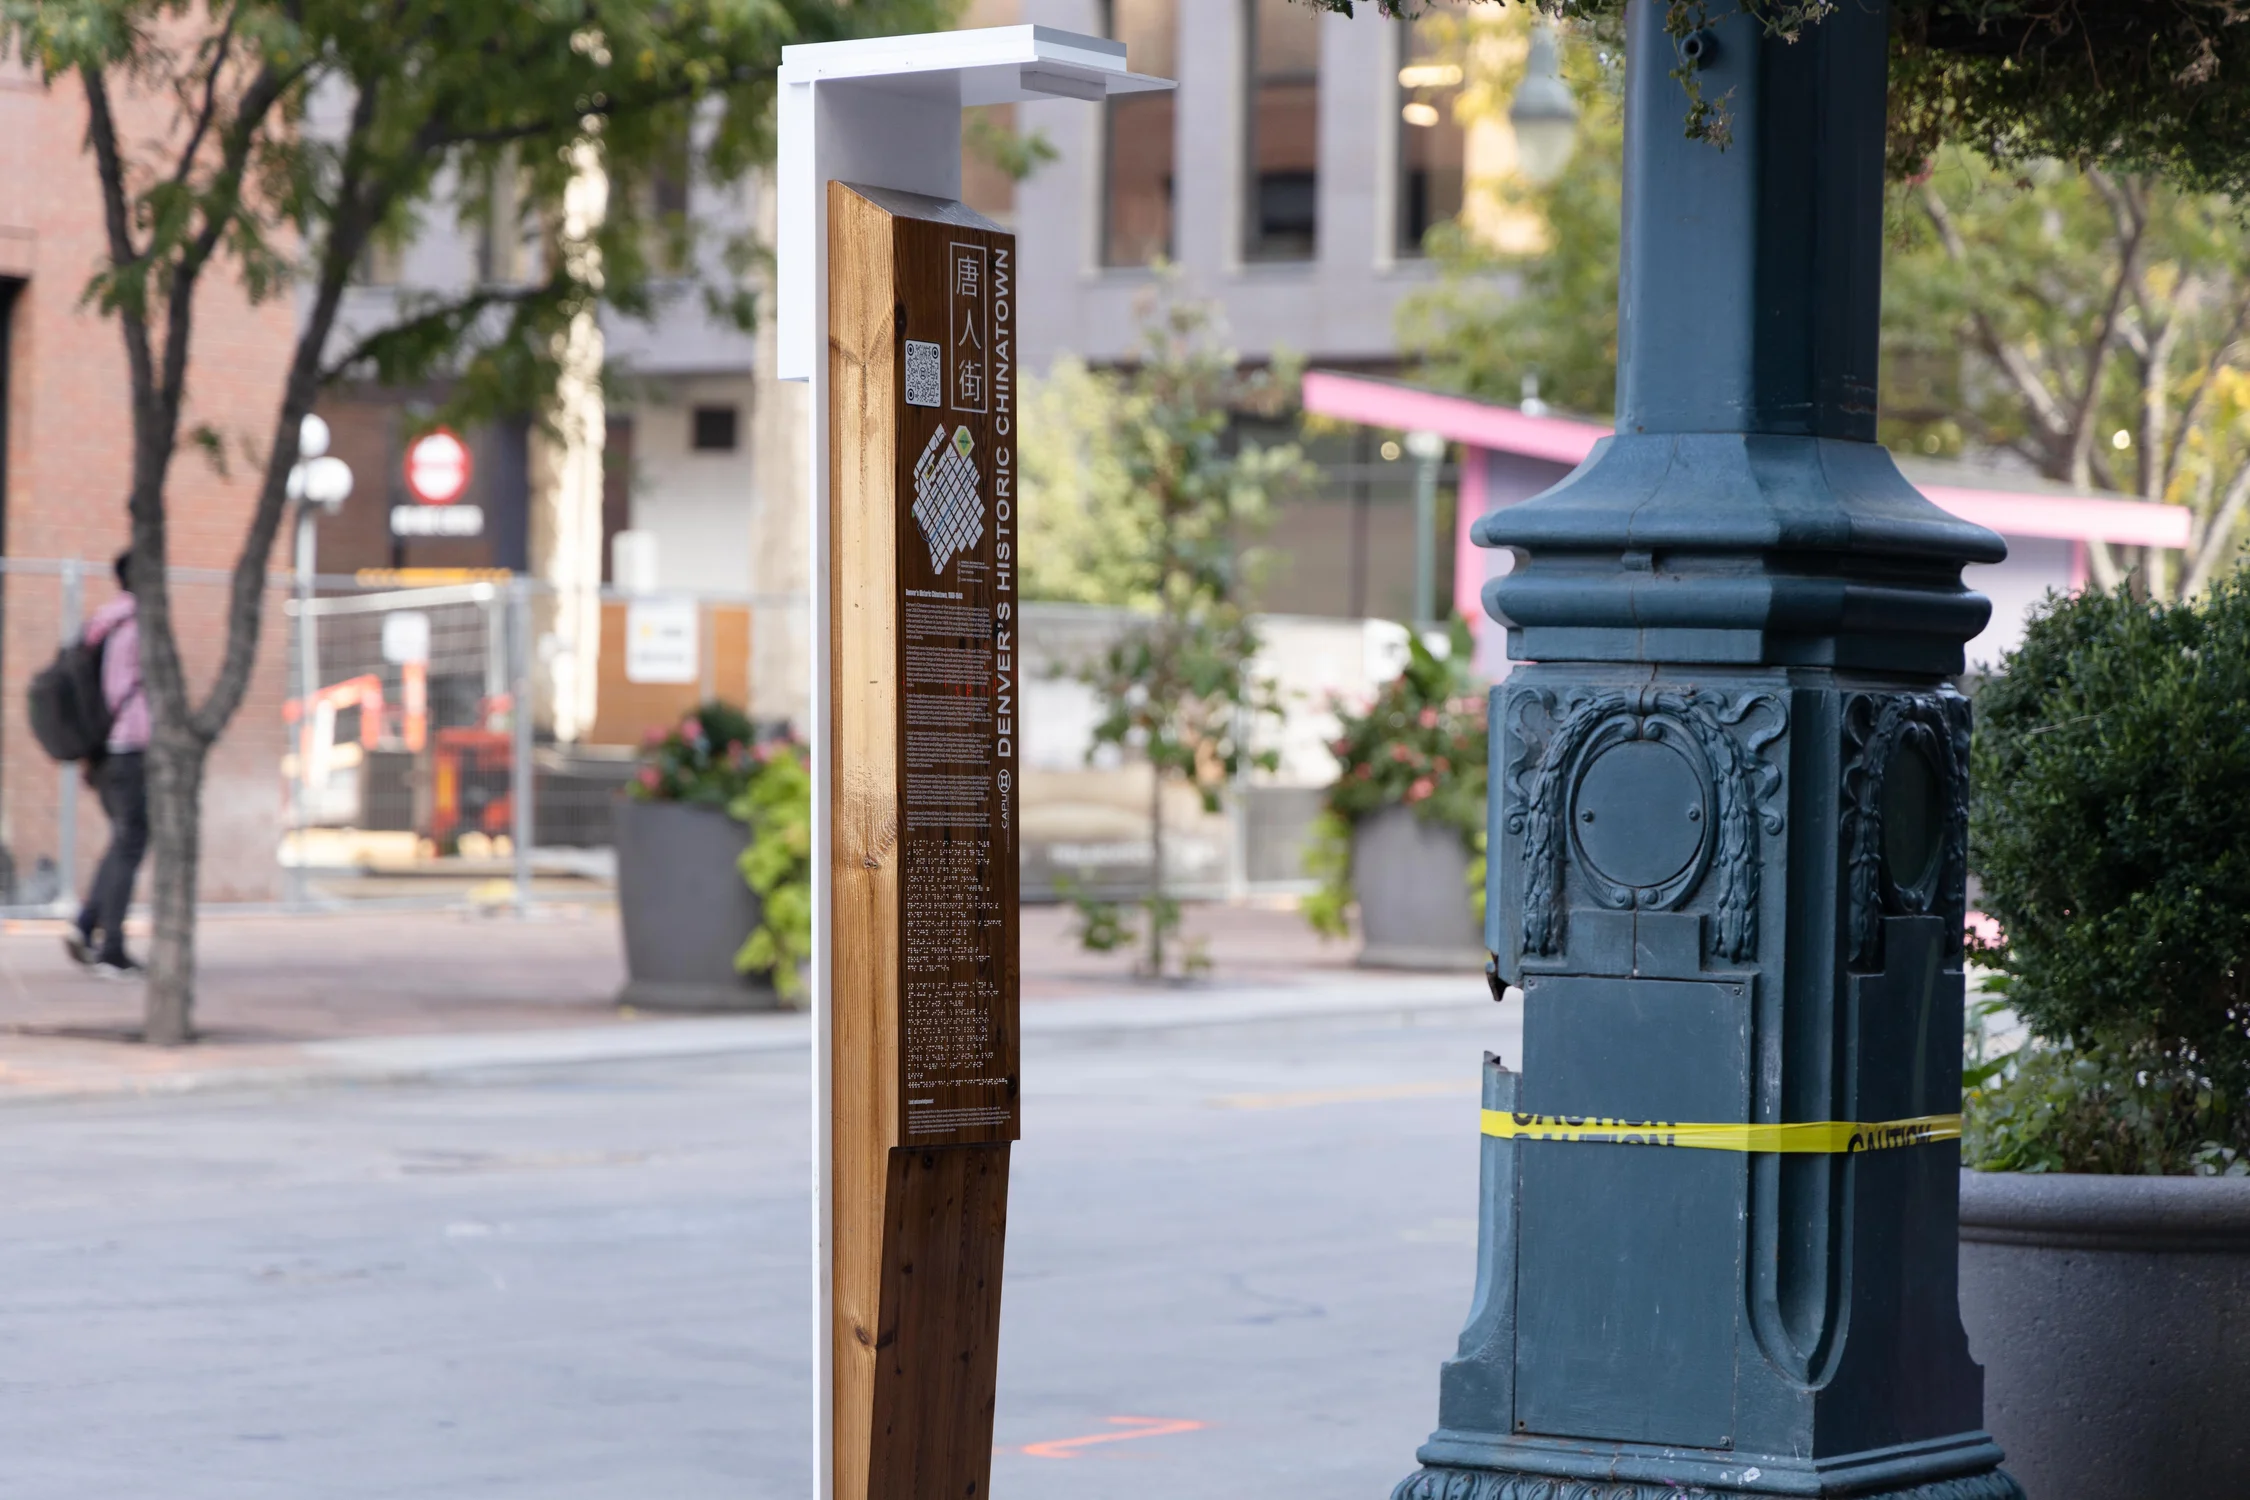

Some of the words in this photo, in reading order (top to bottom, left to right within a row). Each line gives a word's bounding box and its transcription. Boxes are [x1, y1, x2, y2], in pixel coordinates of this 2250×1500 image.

[956, 255, 982, 402] 唐人街
[995, 249, 1009, 436] CHINATOWN
[996, 446, 1010, 591] HISTORIC
[997, 601, 1011, 757] DENVER'S
